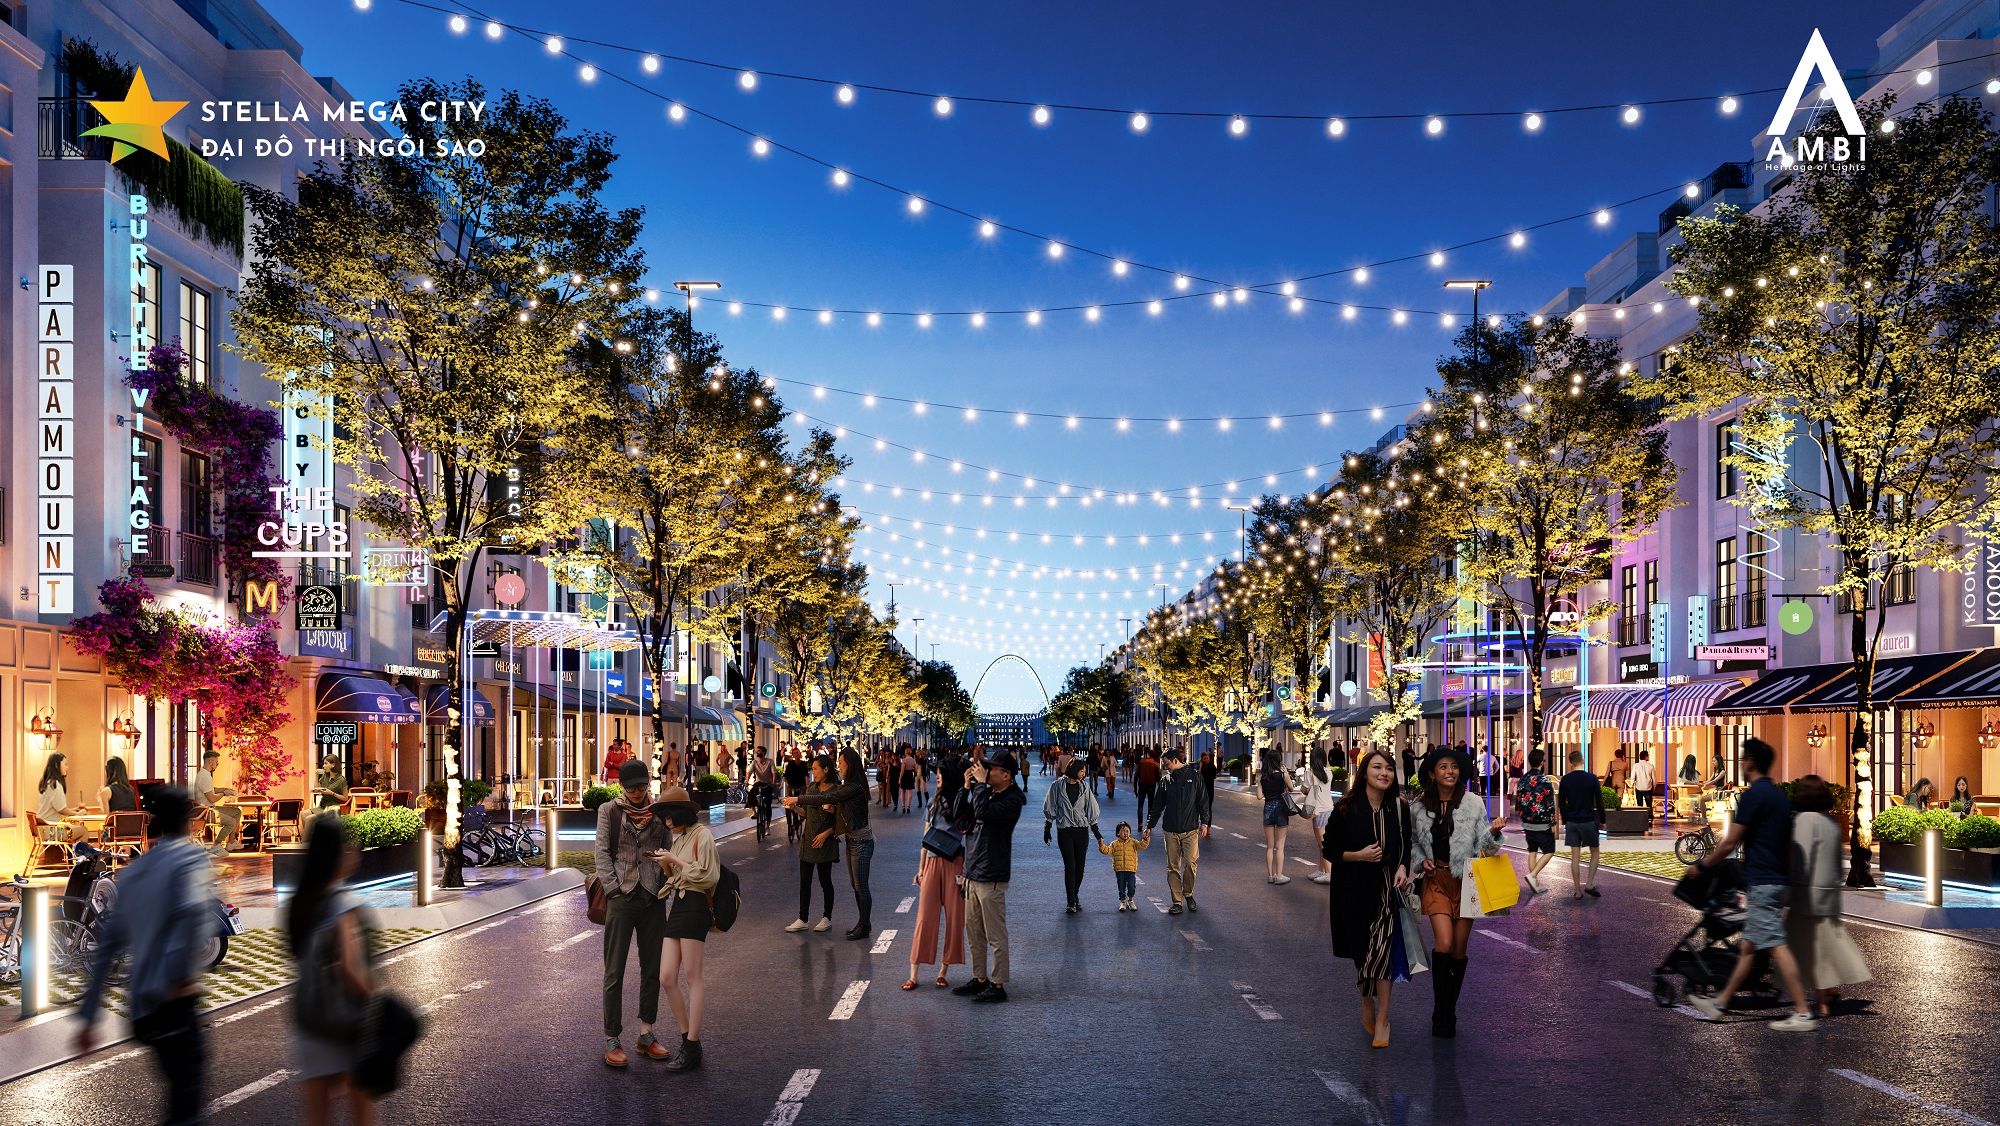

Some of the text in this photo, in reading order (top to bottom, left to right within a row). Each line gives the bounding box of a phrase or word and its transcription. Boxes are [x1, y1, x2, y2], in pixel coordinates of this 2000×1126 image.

[130, 194, 150, 554] BURN THE VILLAGE
[44, 270, 63, 608] PARAMOUNT
[268, 487, 335, 511] THE
[257, 521, 349, 546] CUPS
[372, 553, 422, 567] DRINK
[245, 580, 278, 613] M
[303, 604, 335, 613] Cocktail
[318, 726, 354, 735] LOUNGE
